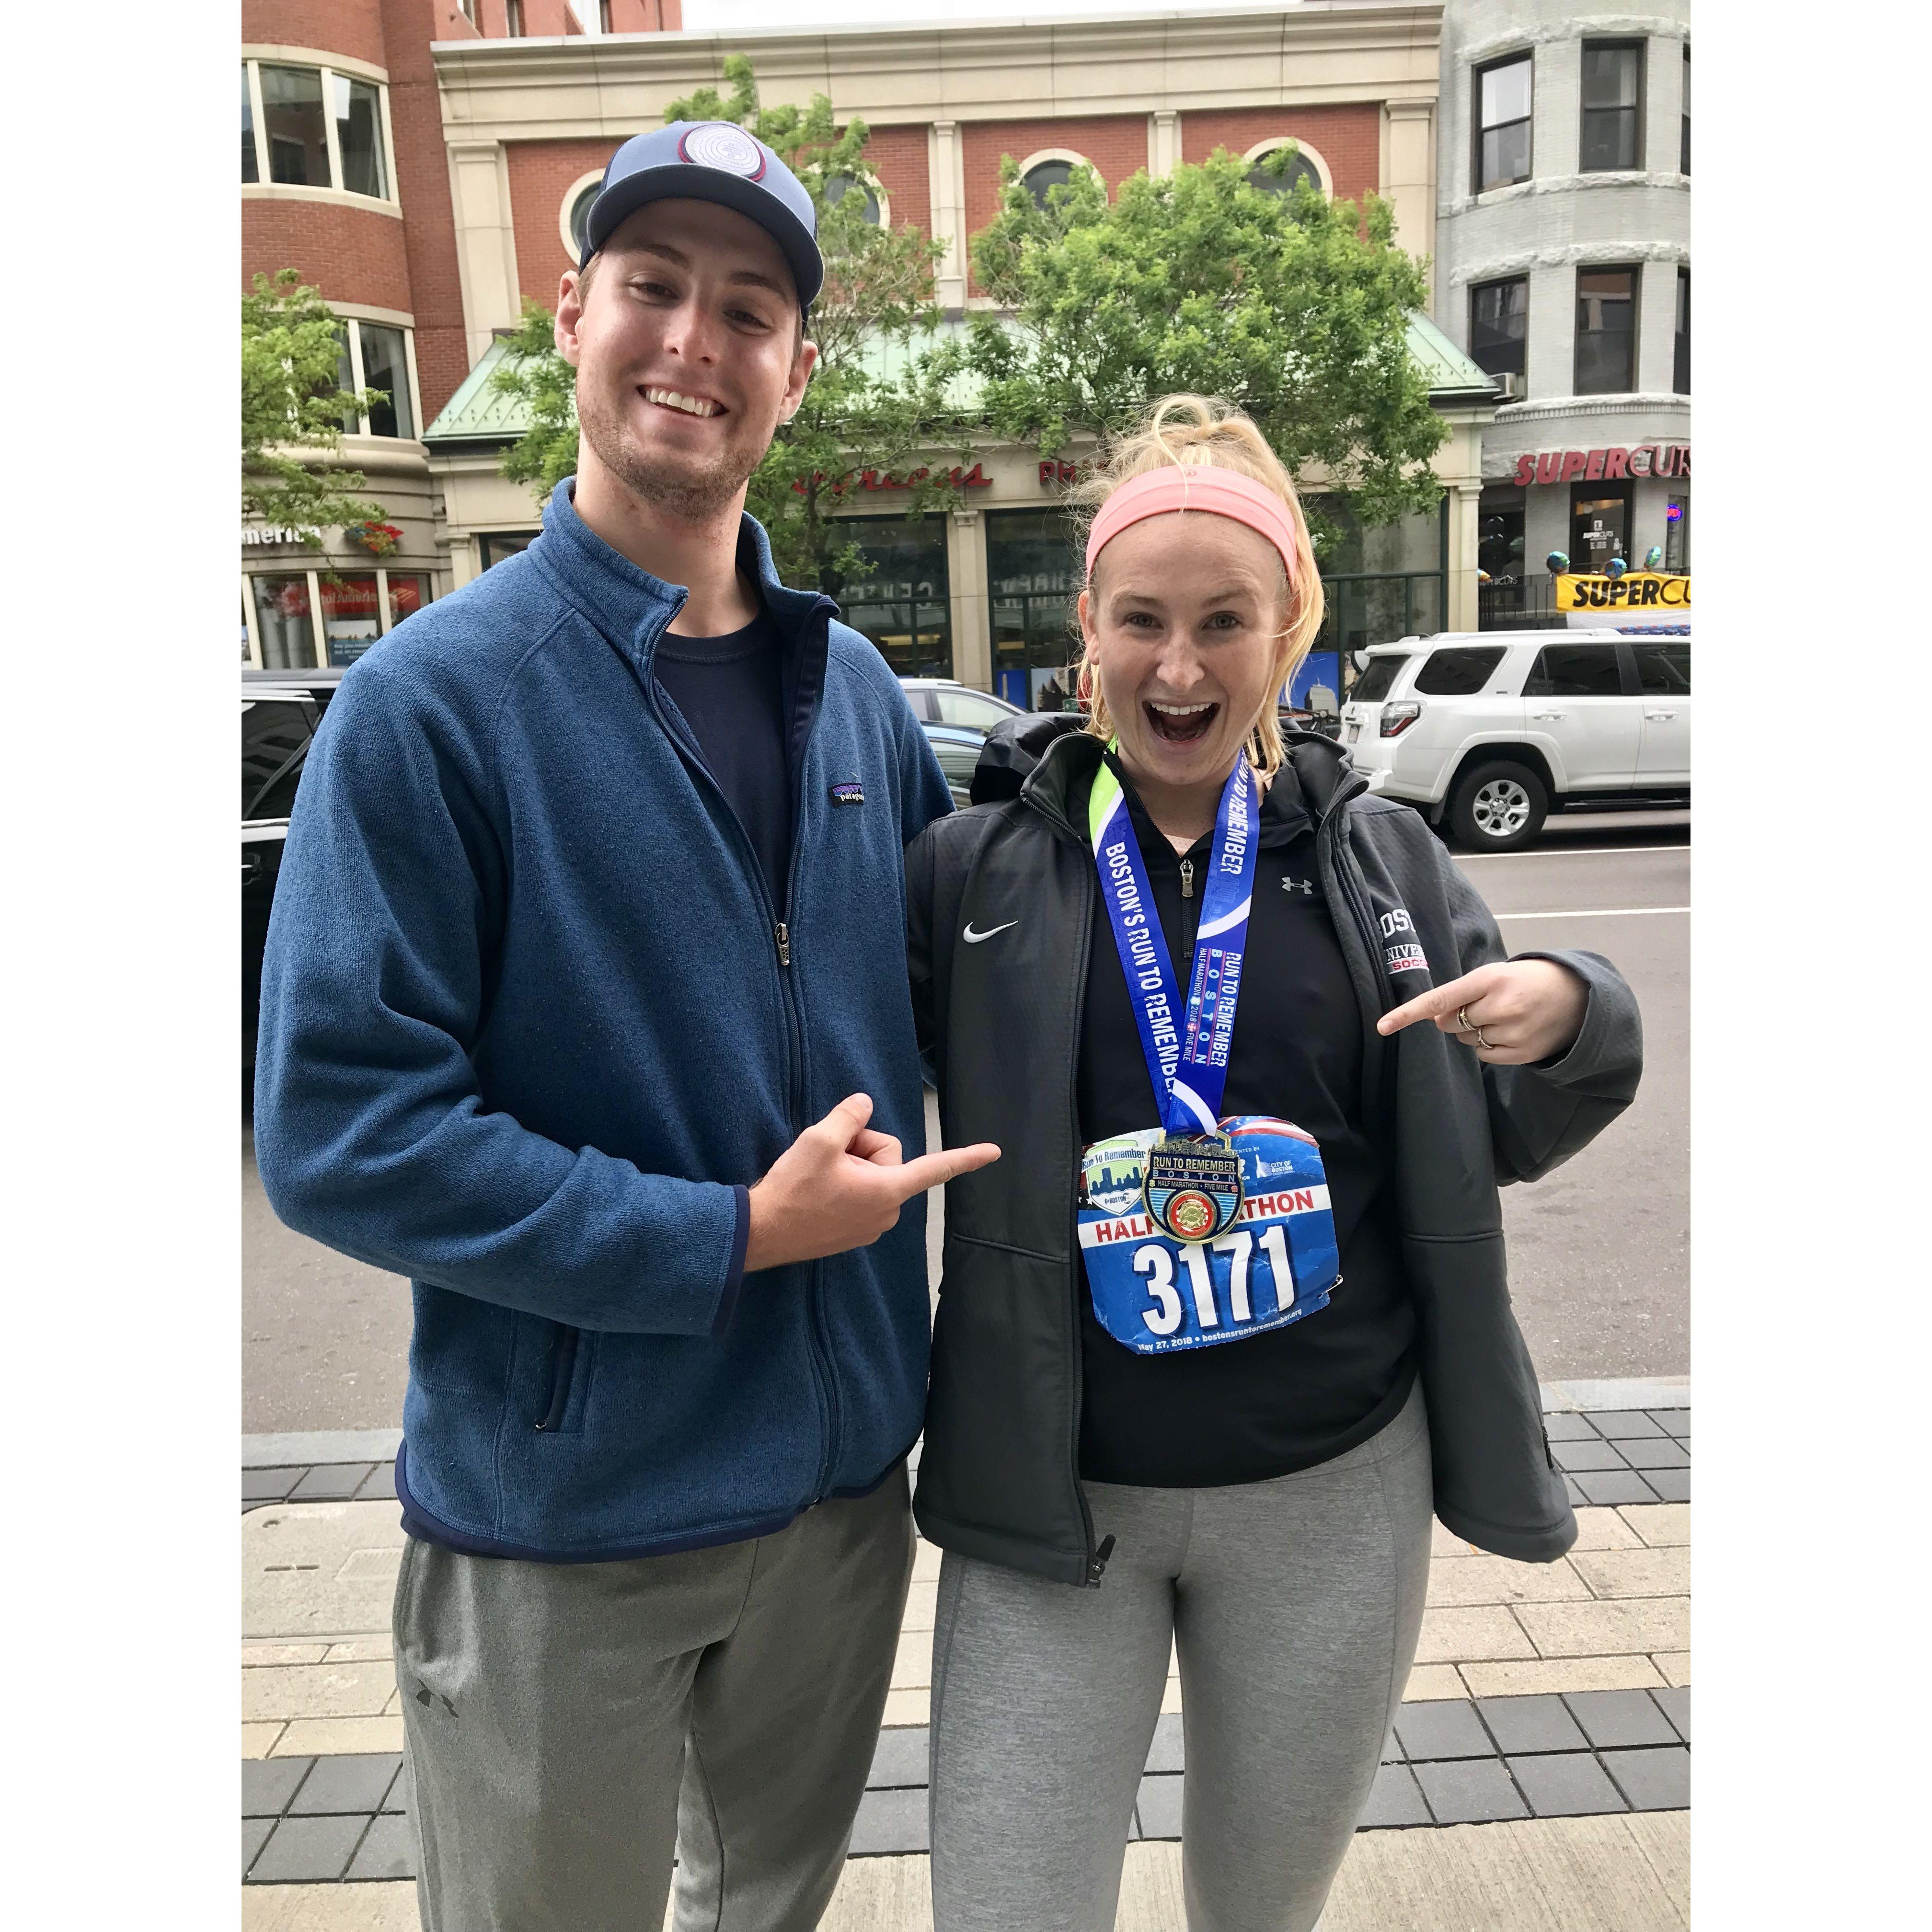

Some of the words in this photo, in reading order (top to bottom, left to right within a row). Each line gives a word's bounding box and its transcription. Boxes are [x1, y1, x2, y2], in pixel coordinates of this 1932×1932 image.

[1234, 776, 1248, 798] TO
[1220, 794, 1248, 875] REMEMBER
[1105, 841, 1145, 927] BOSTON'S
[1127, 928, 1158, 966] RUN
[1198, 948, 1208, 964] HALF
[1138, 965, 1163, 990] TO
[1223, 952, 1242, 978] RUN
[1193, 964, 1206, 996] MARATHON
[1221, 980, 1238, 994] TO
[1189, 1006, 1199, 1023] 2018
[1195, 948, 1223, 1064] BOSTON
[1185, 1032, 1195, 1046] FIVE
[1210, 996, 1236, 1067] REMEMBER
[1183, 1046, 1193, 1061] MILE
[1082, 1158, 1094, 1171] Run
[1094, 1154, 1103, 1163] To
[1104, 1149, 1146, 1161] Remember
[1153, 1156, 1171, 1168] RUN
[1173, 1158, 1184, 1168] TO
[1186, 1159, 1235, 1172] REMEMBER
[1272, 1165, 1293, 1173] BOSTON
[1153, 1170, 1235, 1182] BOSTON
[1239, 1190, 1314, 1220] THON
[1134, 1225, 1295, 1335] 3171
[1172, 1336, 1193, 1347] 2018
[1202, 1308, 1302, 1342] bostonsruntoremember.org
